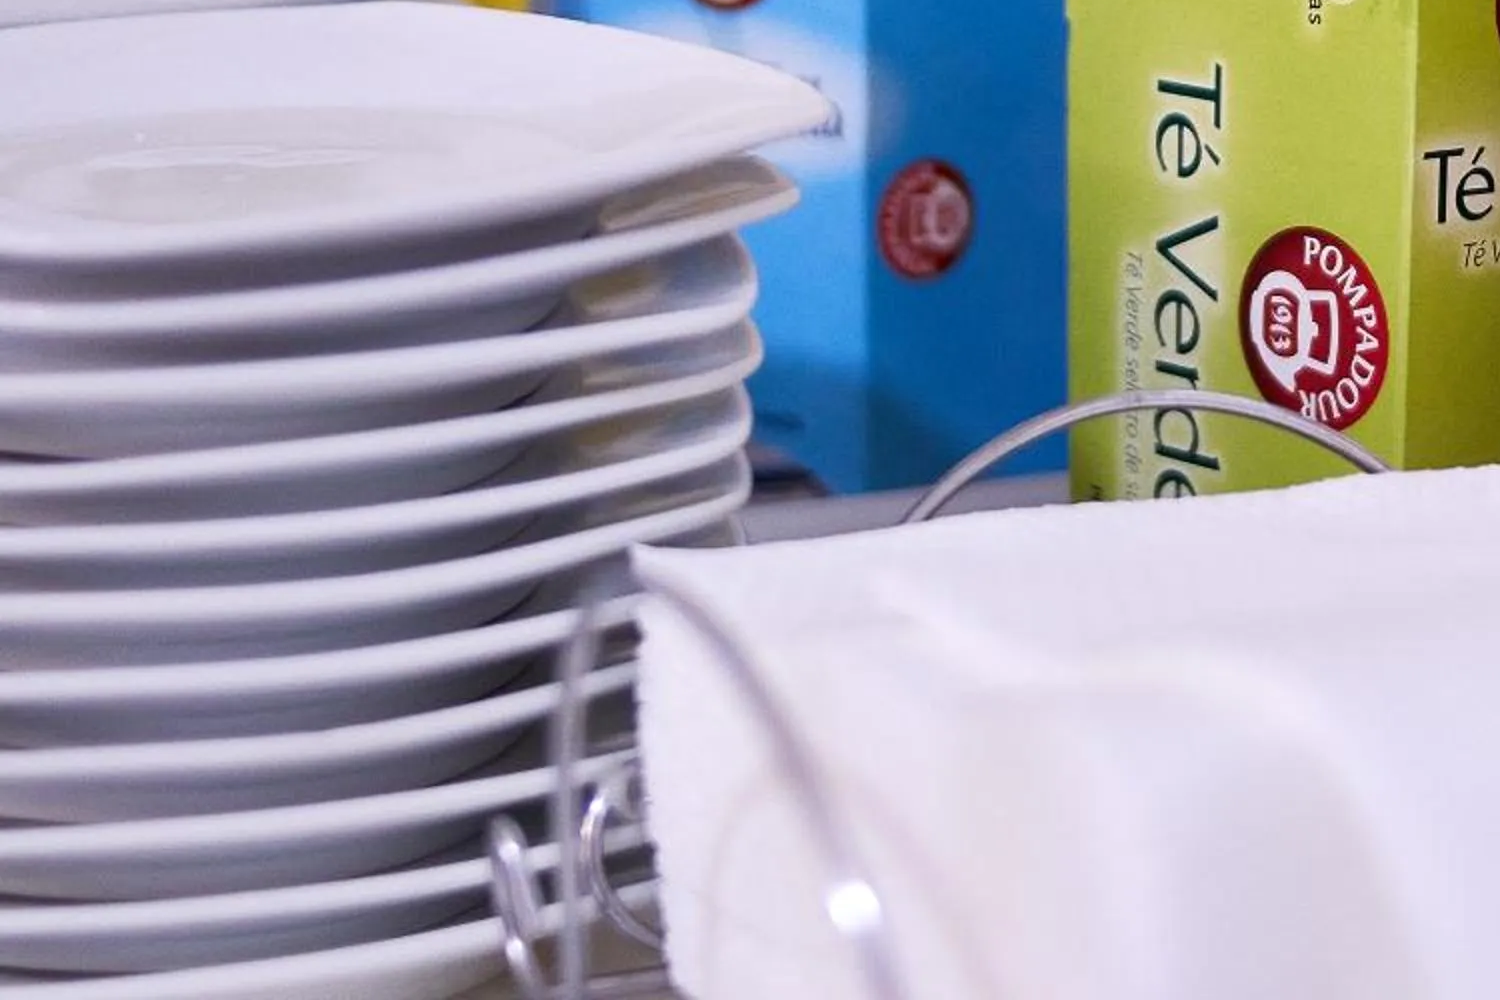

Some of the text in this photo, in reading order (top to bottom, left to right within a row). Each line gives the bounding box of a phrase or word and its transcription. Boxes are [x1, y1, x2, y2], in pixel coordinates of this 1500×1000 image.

[1156, 63, 1222, 180] Té
[1423, 146, 1495, 224] Té
[1125, 252, 1144, 279] Té
[1463, 240, 1485, 268] Té
[1125, 286, 1144, 349] Verde
[1268, 295, 1293, 352] 1913
[1299, 235, 1380, 421] POMPADOUR
[1125, 357, 1144, 439] selto
